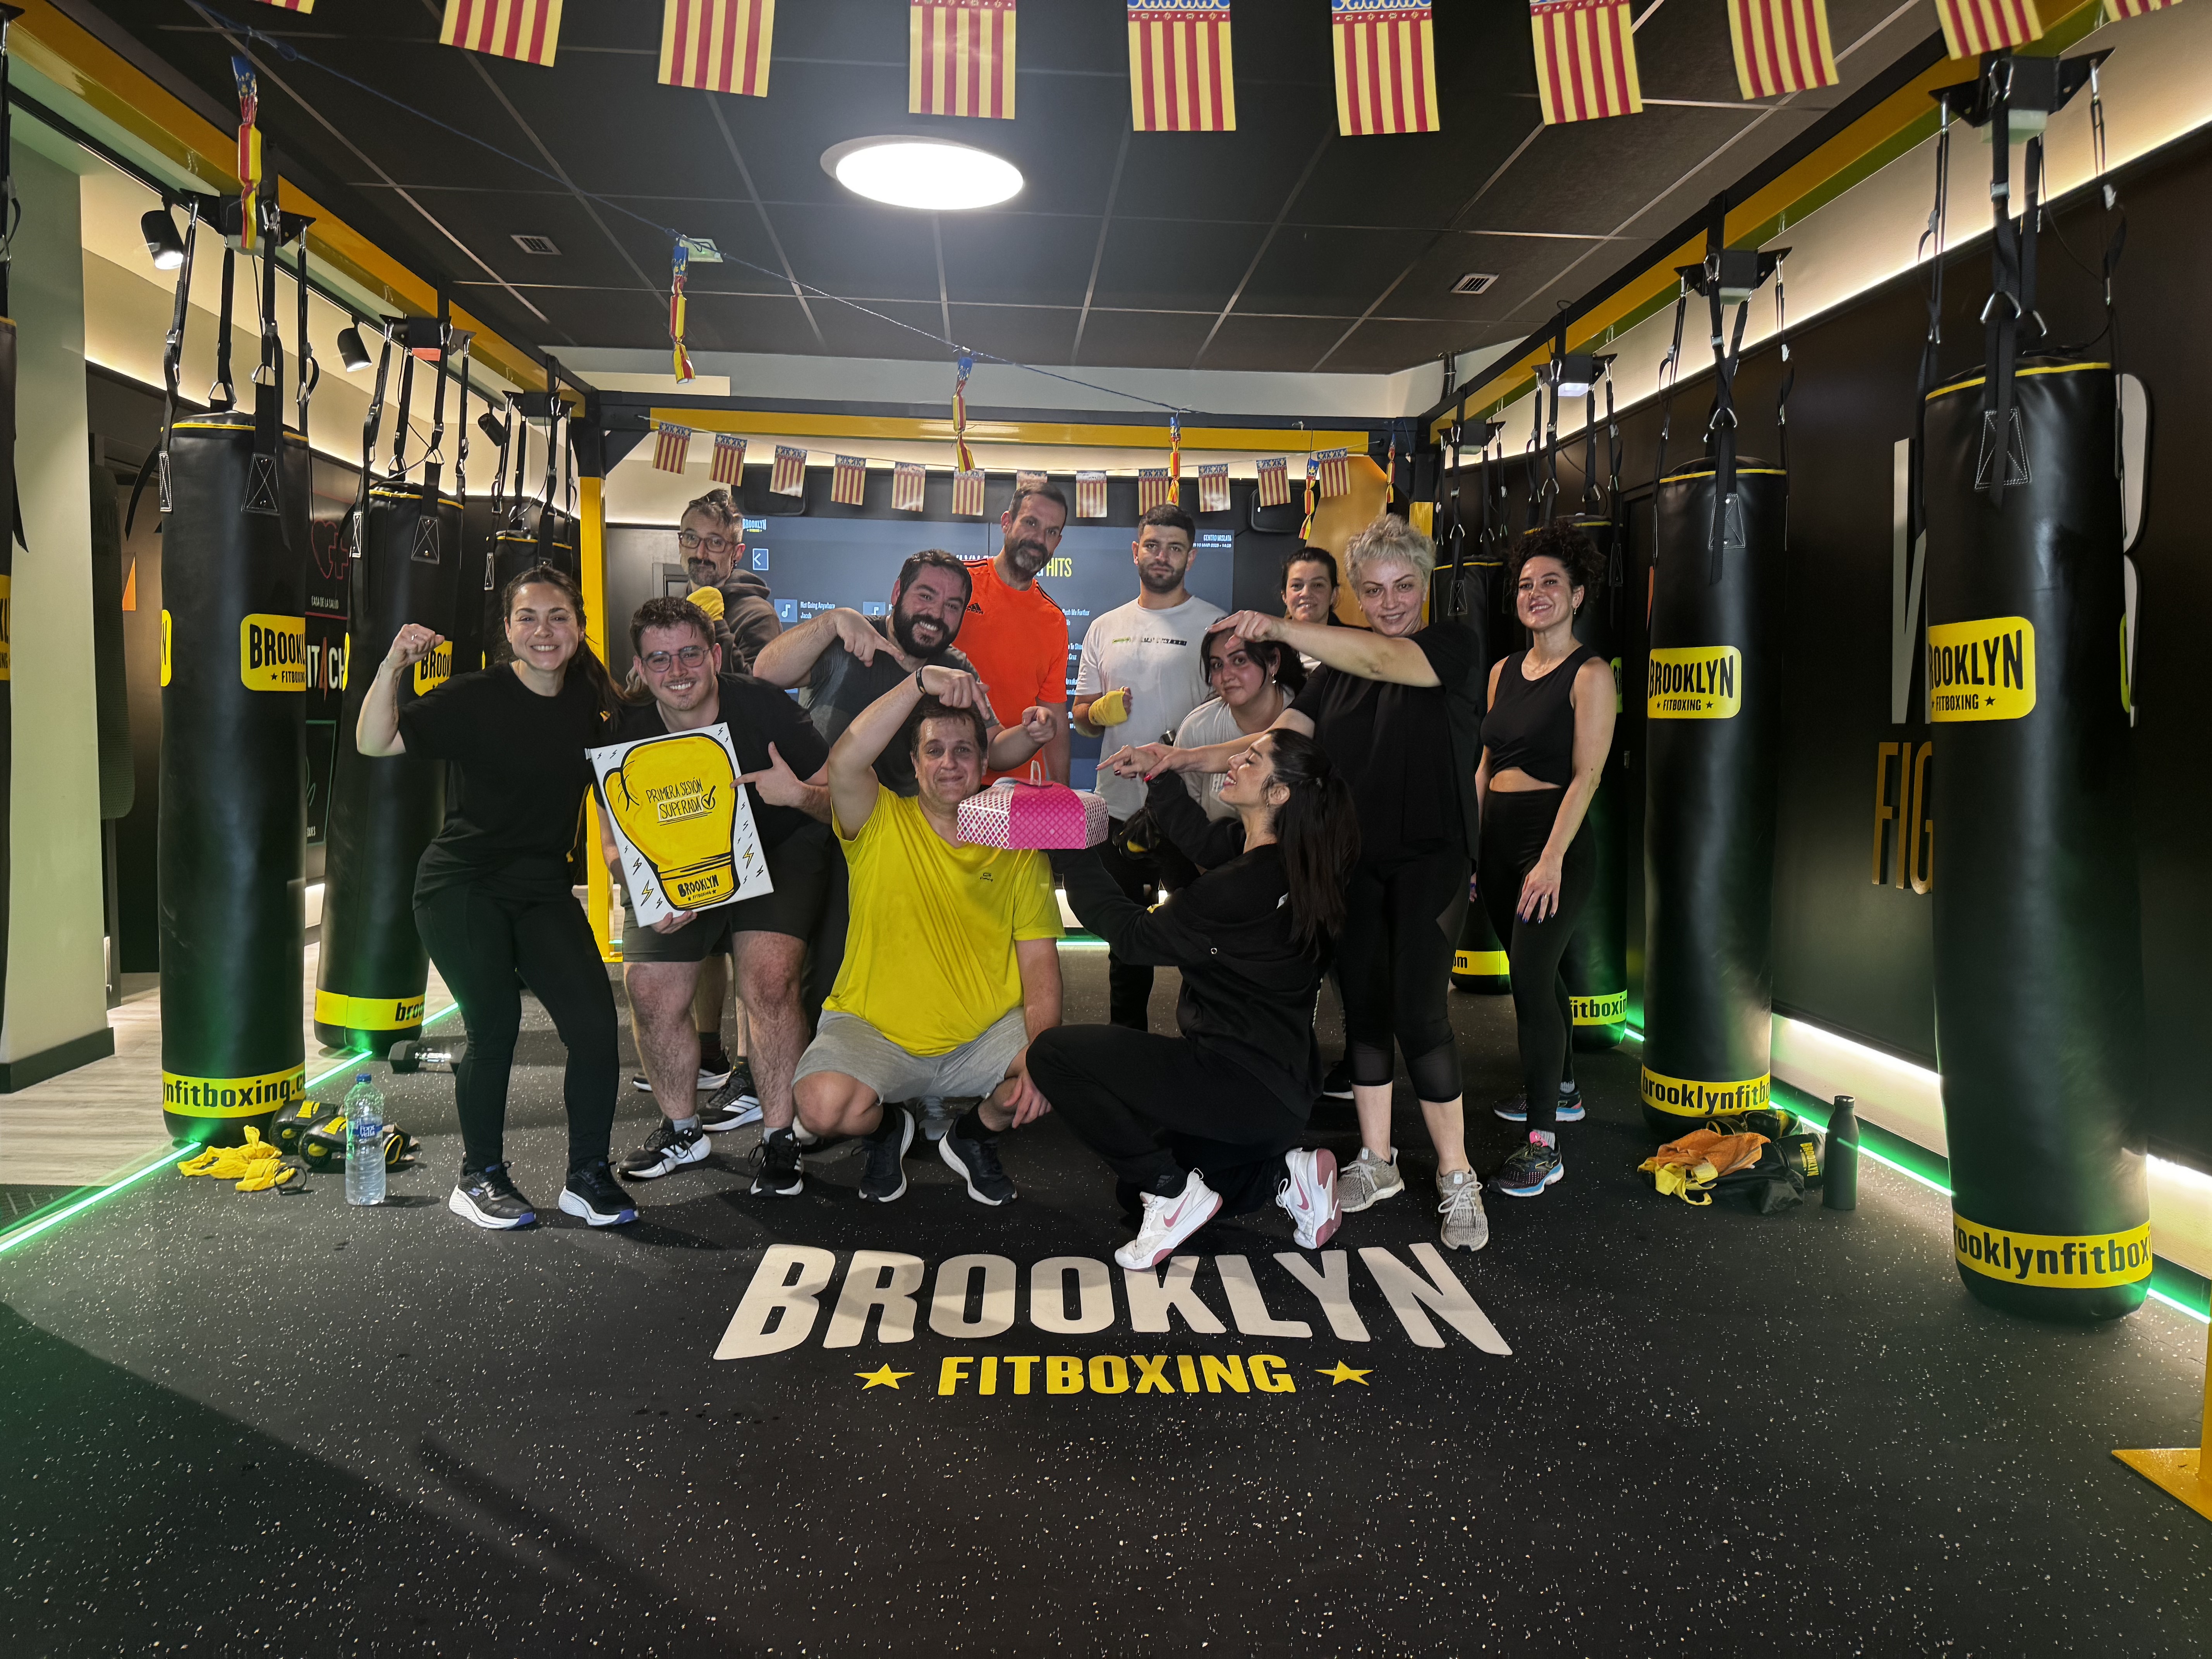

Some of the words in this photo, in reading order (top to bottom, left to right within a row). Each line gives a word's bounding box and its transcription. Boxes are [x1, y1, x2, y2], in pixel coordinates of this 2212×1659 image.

[742, 518, 766, 530] BROOKLYN
[1046, 558, 1072, 577] HITS
[1649, 655, 1734, 699] BROOKLYN
[1663, 699, 1702, 711] FITBOXING
[1936, 694, 1979, 711] FITBOXING
[646, 783, 680, 804] PRIMERA
[680, 776, 704, 796] SESIÓN
[659, 797, 702, 819] SUPERADA
[677, 874, 719, 897] BROOKLYN
[713, 1242, 1513, 1360] BROOKLYN
[938, 1355, 1296, 1395] FITBOXING
